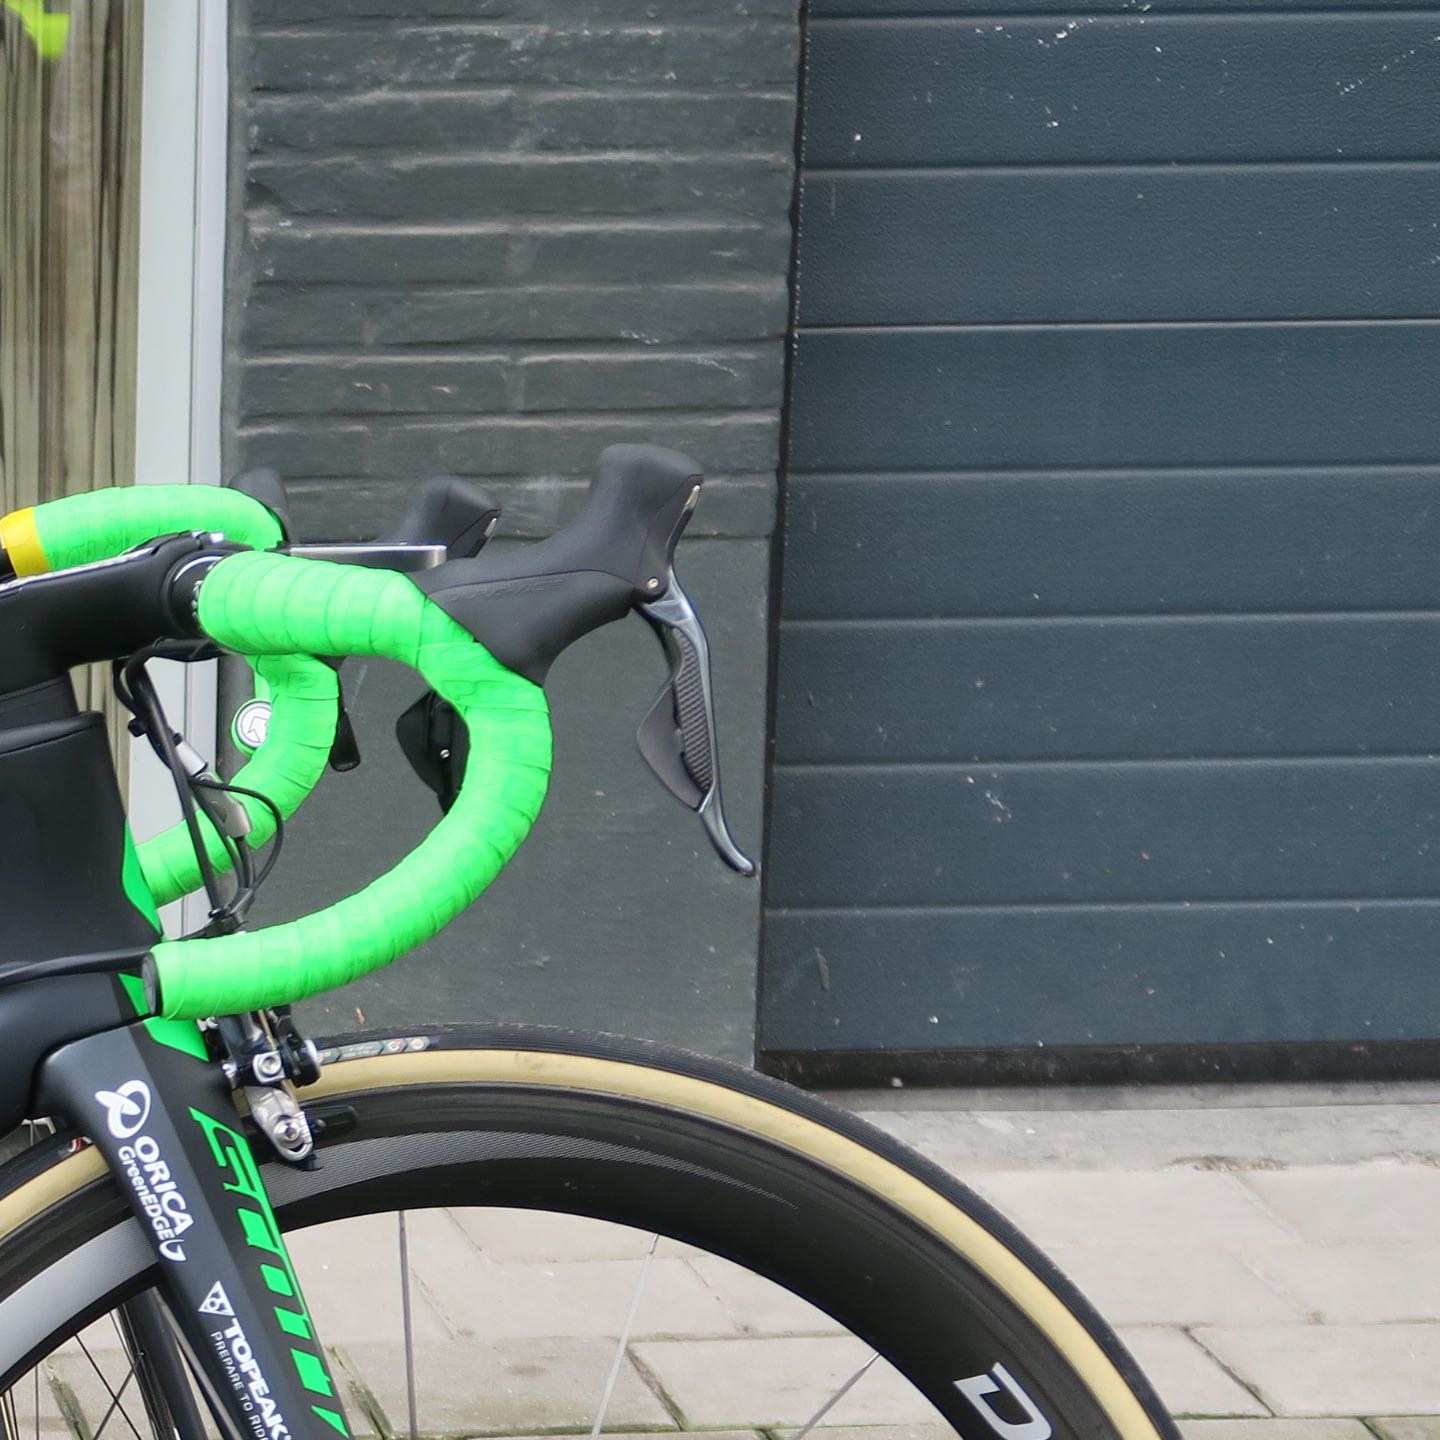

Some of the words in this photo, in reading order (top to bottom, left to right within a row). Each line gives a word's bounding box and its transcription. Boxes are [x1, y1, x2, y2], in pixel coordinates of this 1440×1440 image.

[117, 1145, 176, 1241] GreenEDGE
[134, 1135, 196, 1237] ORICA
[210, 1331, 245, 1392] PREPARE
[239, 1389, 254, 1412] TO
